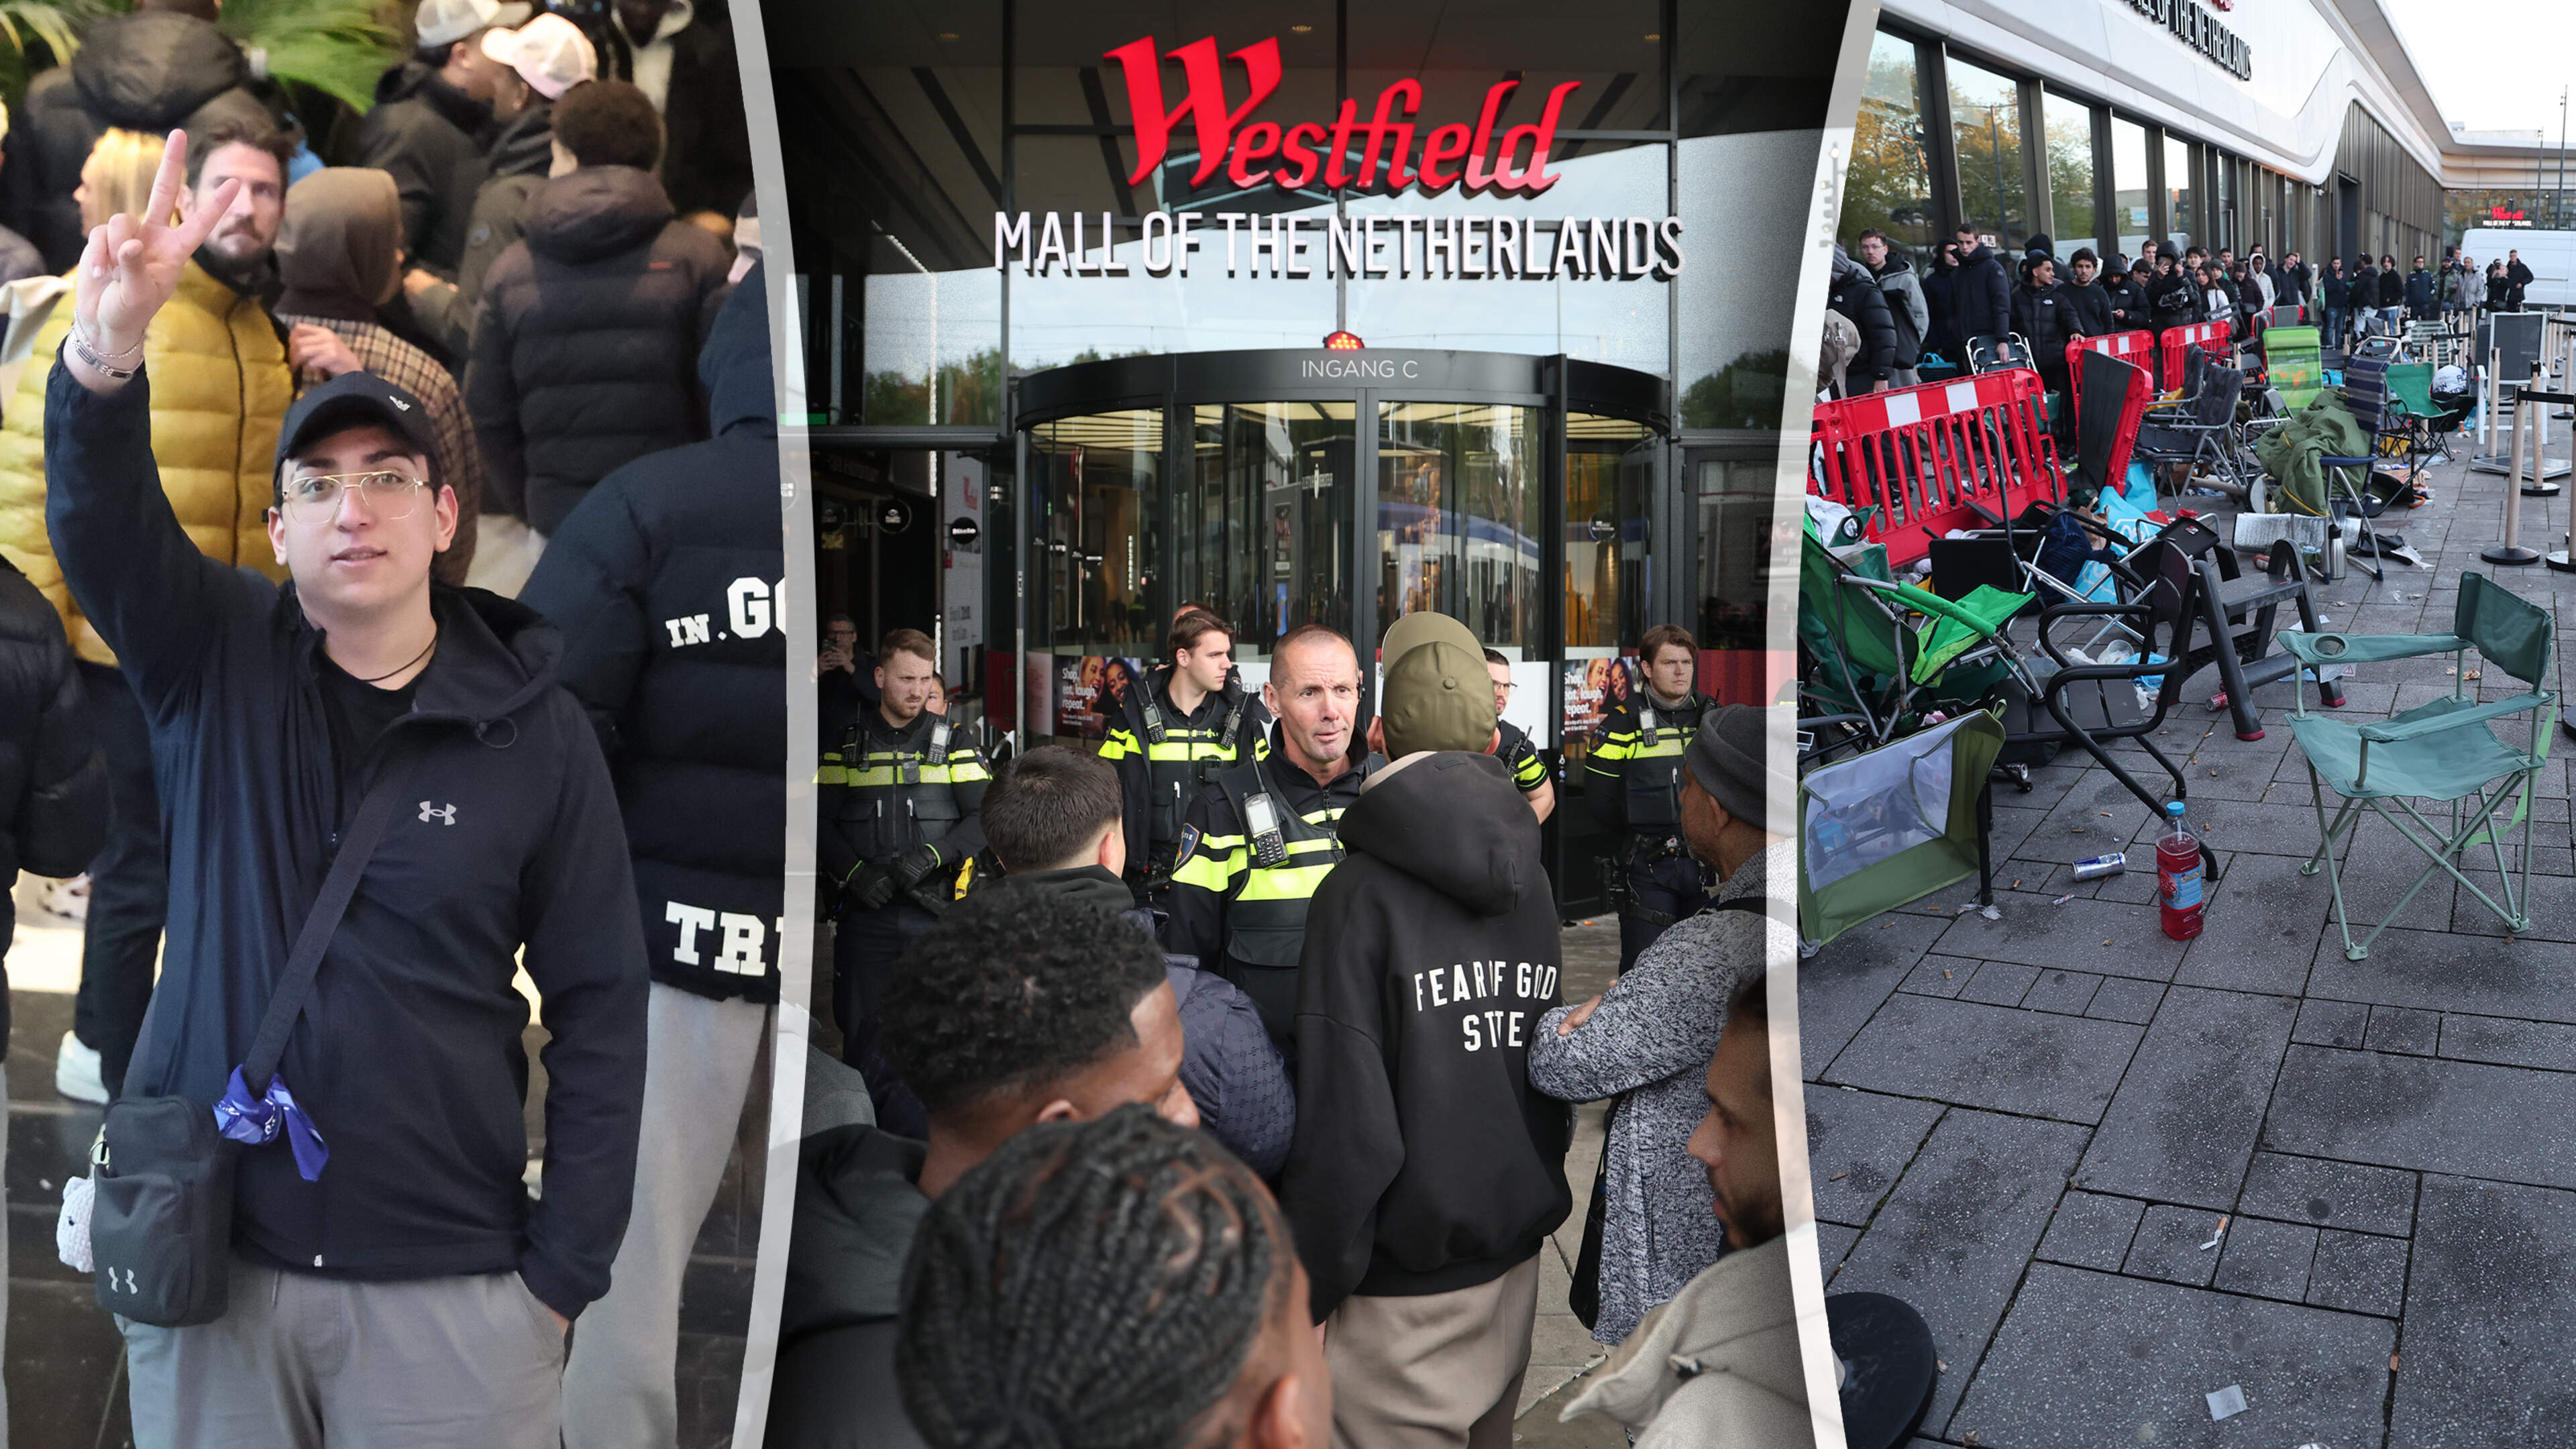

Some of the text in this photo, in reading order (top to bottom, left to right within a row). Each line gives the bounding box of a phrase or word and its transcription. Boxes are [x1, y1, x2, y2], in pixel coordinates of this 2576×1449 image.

[2194, 3, 2252, 81] NETHERLANDS
[1103, 34, 1583, 195] Westfield
[994, 211, 1686, 279] MALL OF THE NETHERLANDS
[1301, 359, 1419, 379] INGANG C
[1062, 667, 1079, 682] Shop,
[1062, 683, 1098, 700] eat, laugh,
[1062, 699, 1085, 712] repeat.
[1580, 686, 1604, 703] laugh,
[665, 900, 784, 977] TR
[1413, 961, 1487, 1012] FEAR
[1516, 962, 1558, 1001] GOD
